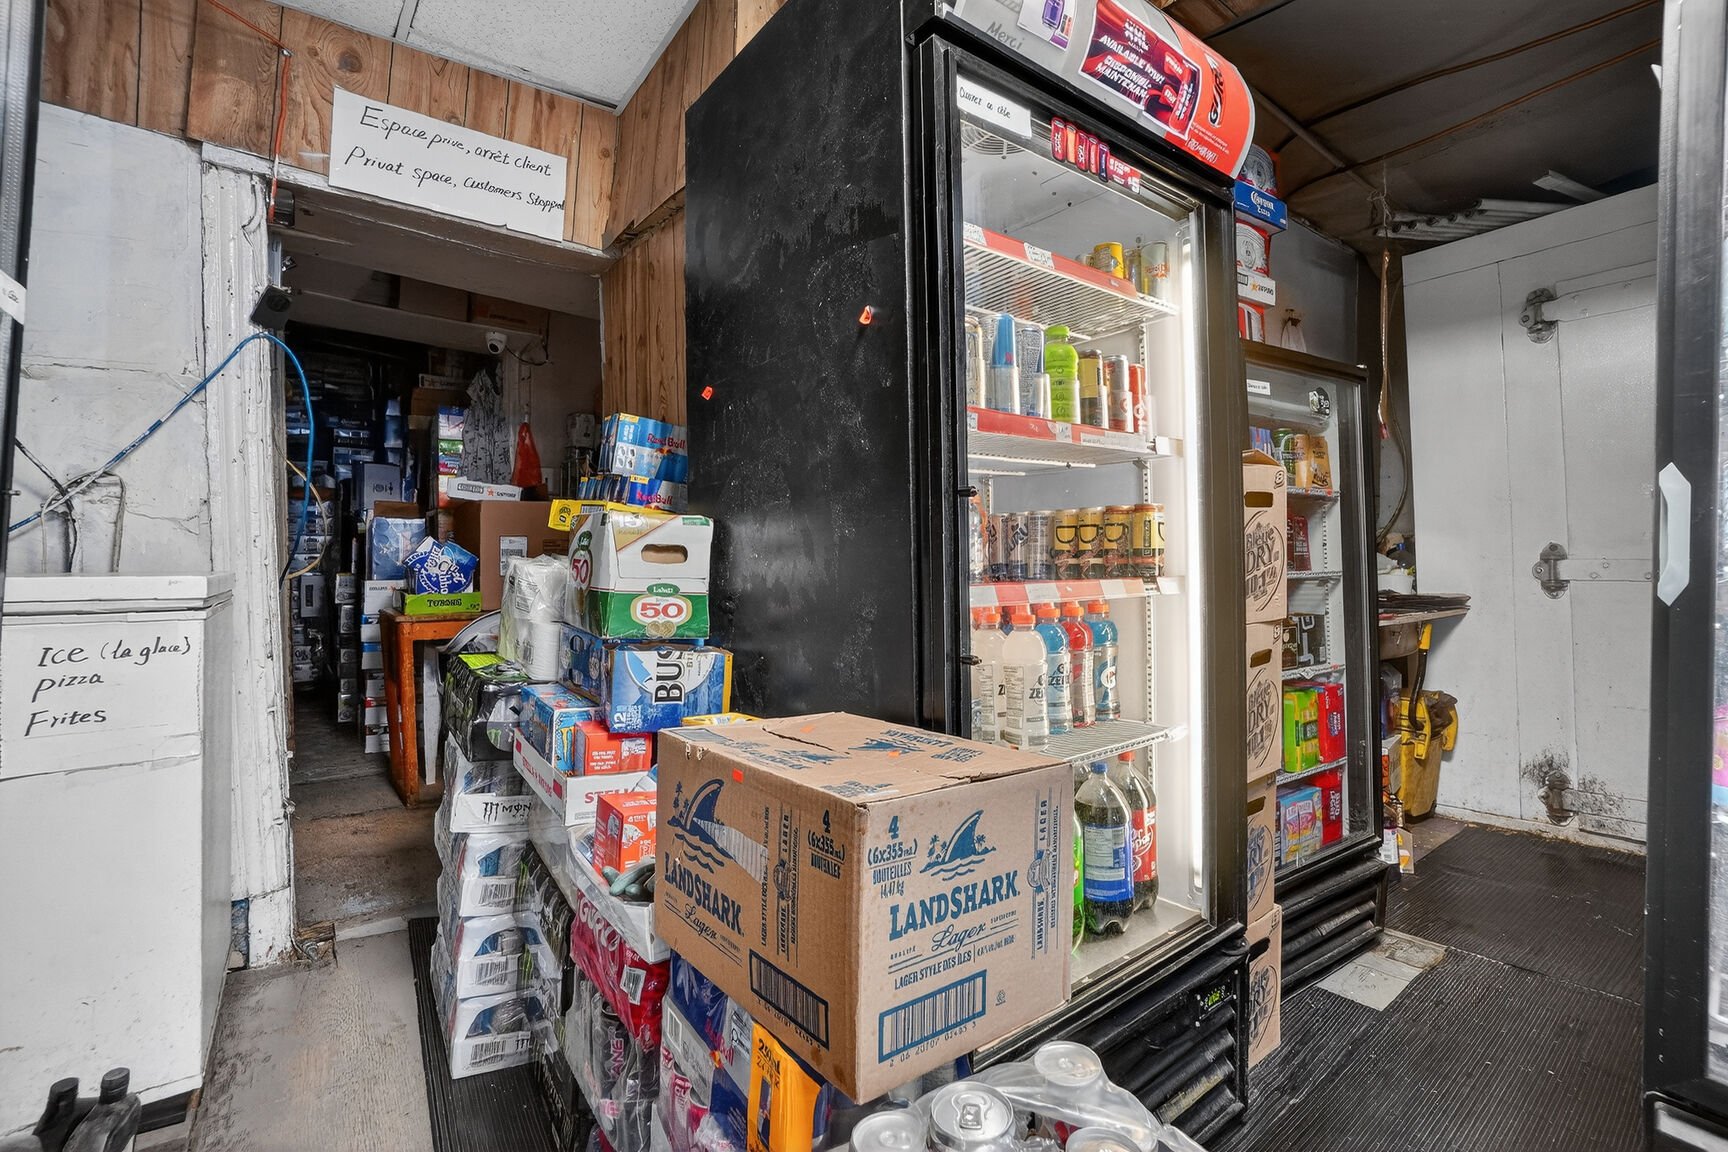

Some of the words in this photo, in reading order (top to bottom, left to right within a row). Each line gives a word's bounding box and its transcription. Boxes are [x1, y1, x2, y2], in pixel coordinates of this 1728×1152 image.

[985, 21, 1024, 50] Merci
[1099, 35, 1146, 69] AVAILABLE
[360, 106, 428, 140] Espace
[474, 144, 510, 165] arrêt
[344, 145, 404, 175] Privat
[411, 166, 457, 188] space,
[1251, 191, 1275, 211] Corona
[667, 437, 686, 449] Bull
[571, 558, 589, 584] 50
[1246, 540, 1276, 577] DRY
[640, 602, 684, 619] 50
[37, 646, 89, 667] Ice
[133, 636, 192, 666] glace)
[24, 709, 107, 736] Frites
[782, 814, 790, 853] LAGER
[822, 808, 831, 834] 4
[888, 815, 899, 840] 4
[1039, 799, 1048, 841] LAGER
[872, 861, 912, 885] BOUTEILLES
[664, 851, 742, 936] LANDSHARK
[889, 869, 1018, 942] LANDSHARK
[684, 903, 717, 940] Lager
[931, 922, 986, 953] Lager
[894, 970, 919, 990] LAGER
[919, 958, 943, 981] STYLE
